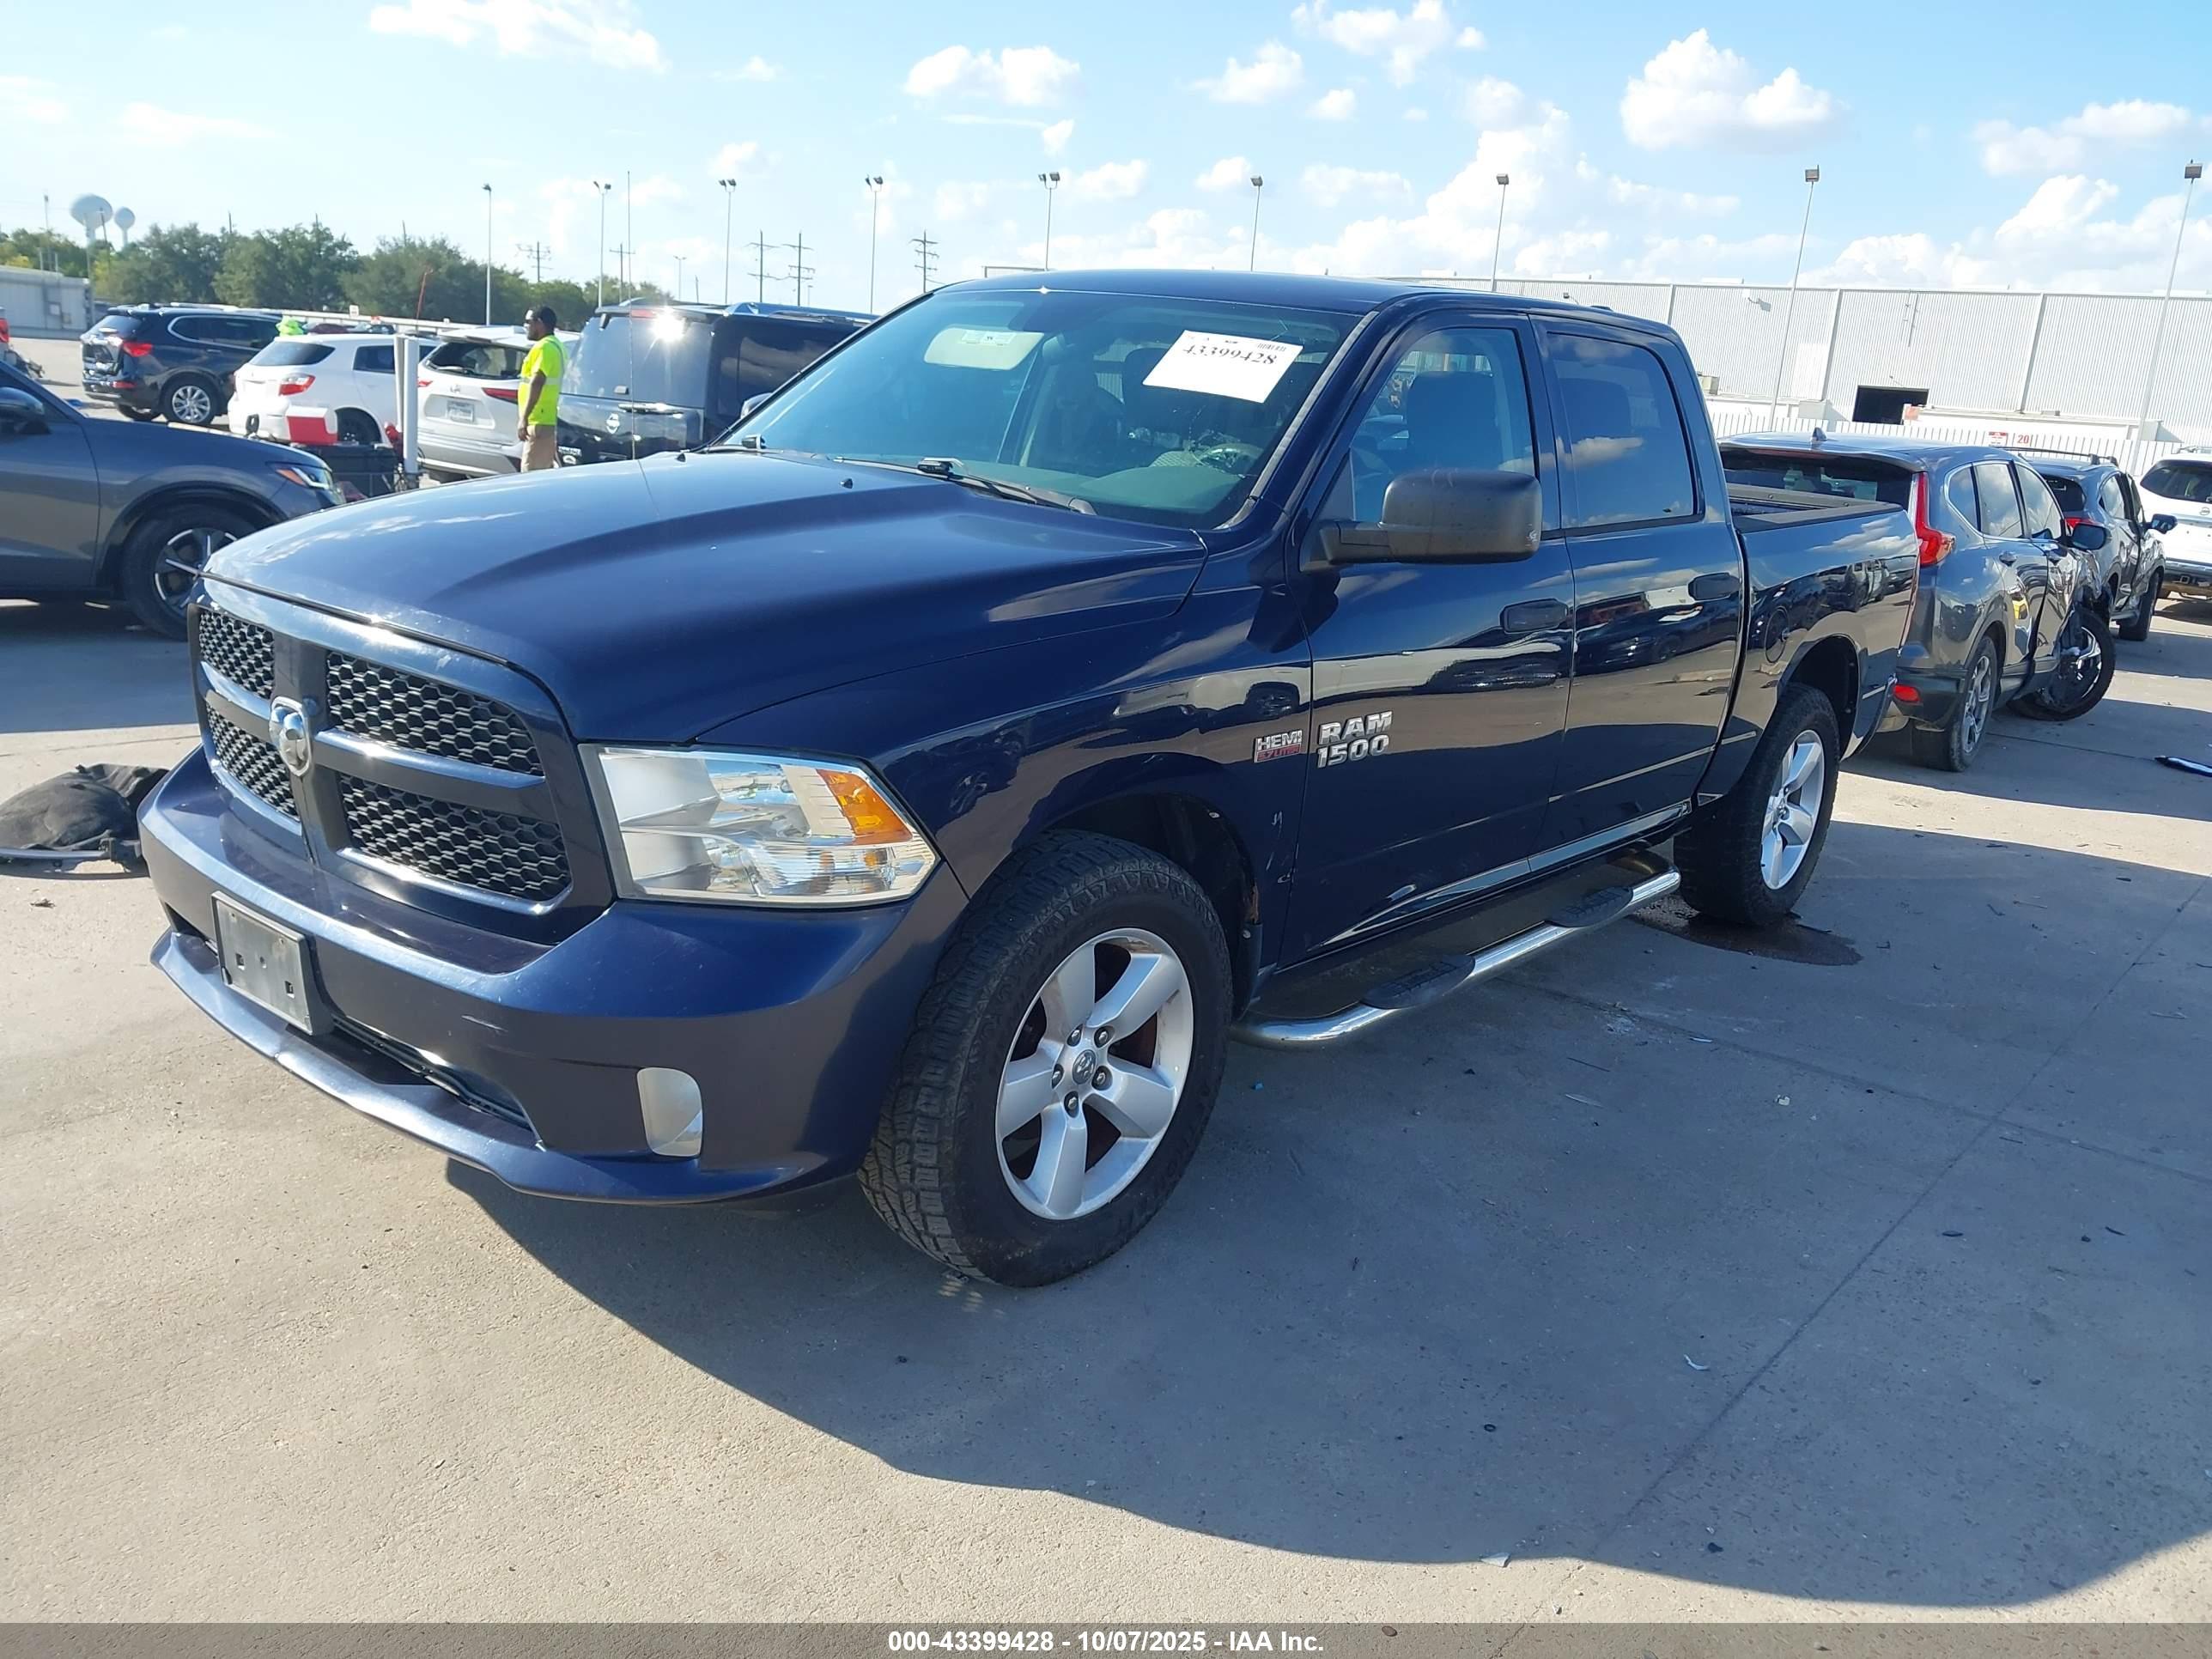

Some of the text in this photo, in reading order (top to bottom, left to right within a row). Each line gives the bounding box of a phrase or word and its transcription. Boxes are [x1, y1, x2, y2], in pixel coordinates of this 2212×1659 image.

[1183, 344, 1278, 365] 43399428
[2017, 434, 2030, 444] 20
[1319, 710, 1393, 745] RAM
[1257, 730, 1303, 750] HEMI
[1317, 735, 1389, 769] 1500
